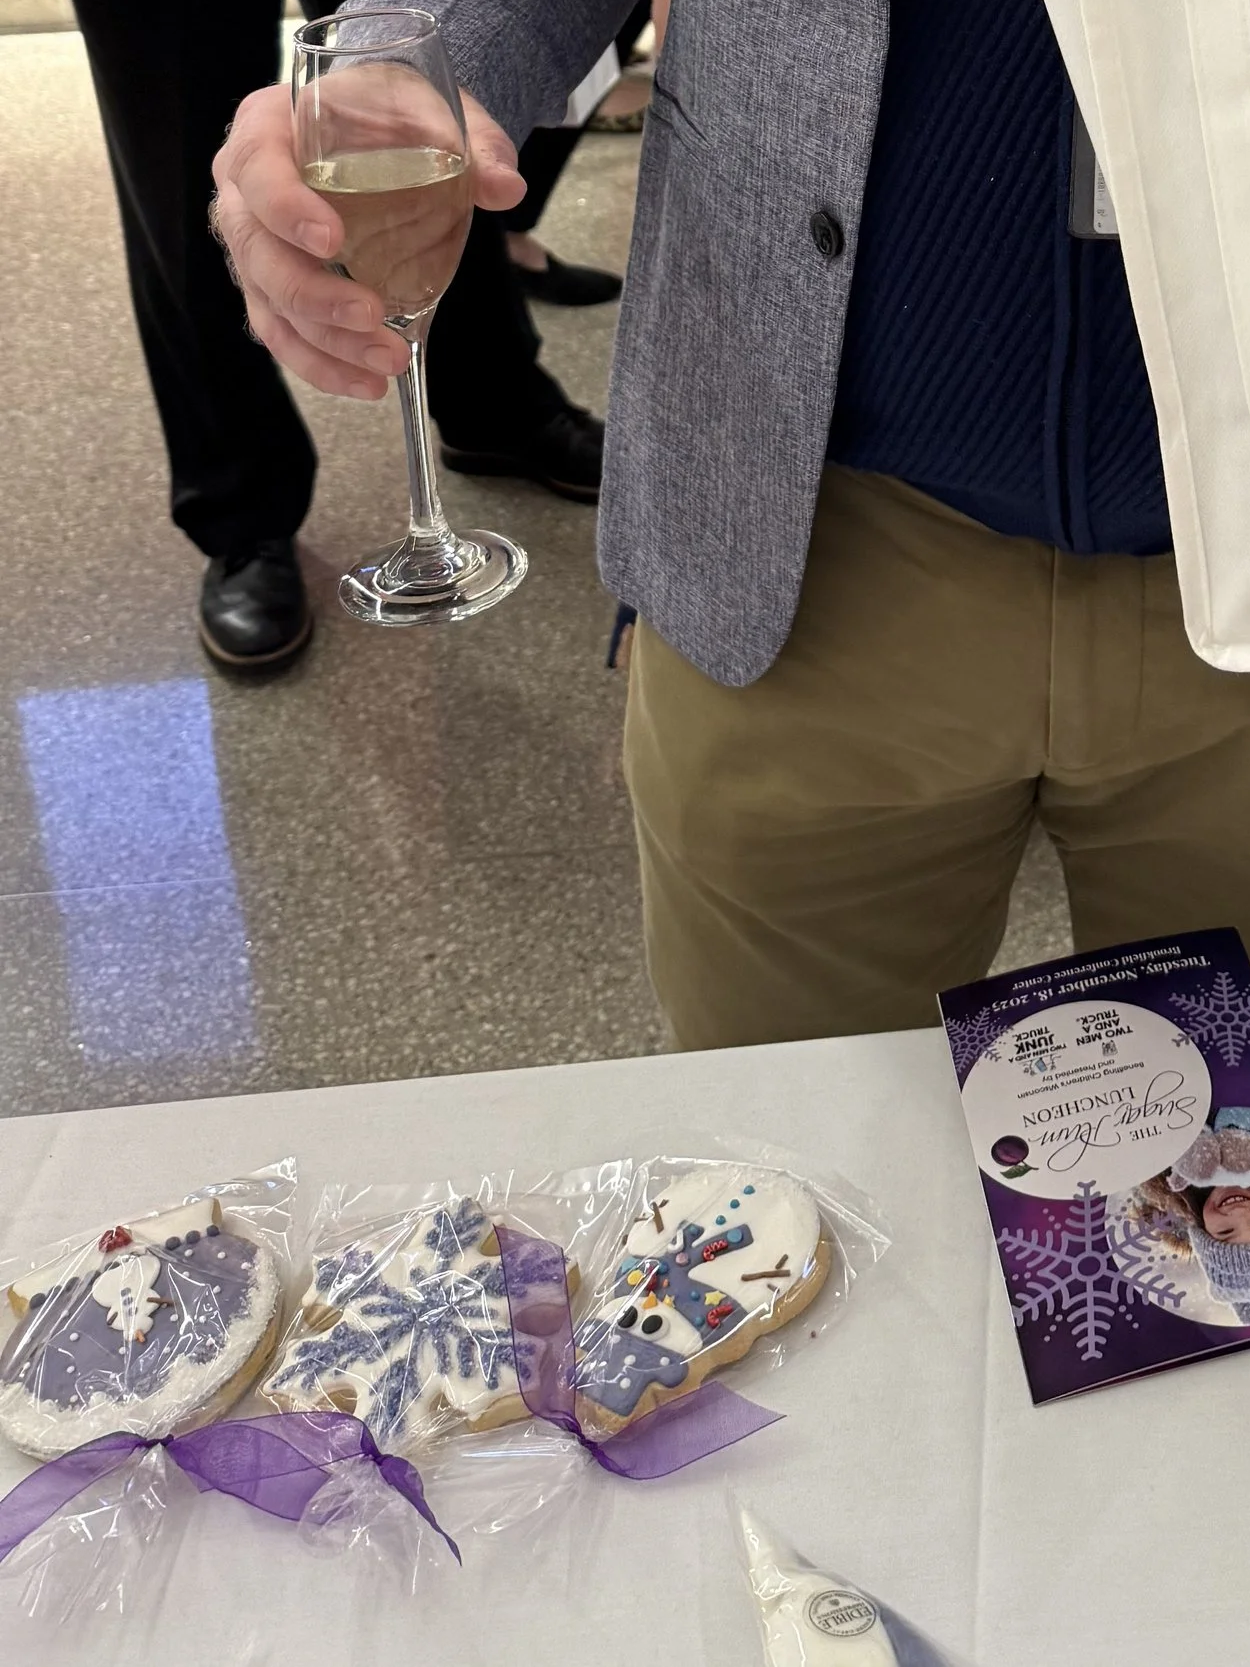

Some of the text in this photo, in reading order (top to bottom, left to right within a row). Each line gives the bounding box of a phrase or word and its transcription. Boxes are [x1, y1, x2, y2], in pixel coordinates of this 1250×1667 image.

[1012, 946, 1181, 991] Brookfield Conference Center
[1059, 969, 1138, 995] November
[992, 994, 1030, 1012] 2025
[1094, 1018, 1120, 1030] AND
[1016, 1035, 1055, 1054] JUNK
[1076, 1025, 1133, 1046] TWO MEN
[1042, 1059, 1115, 1083] and Presented by
[1061, 1071, 1102, 1086] Children's
[1017, 1083, 1059, 1099] Wisconsin
[1023, 1086, 1136, 1128] LUNCHEON
[1028, 1071, 1196, 1172] Sugar Plum
[1131, 1125, 1162, 1141] THE
[818, 1606, 873, 1629] EDIBLE
